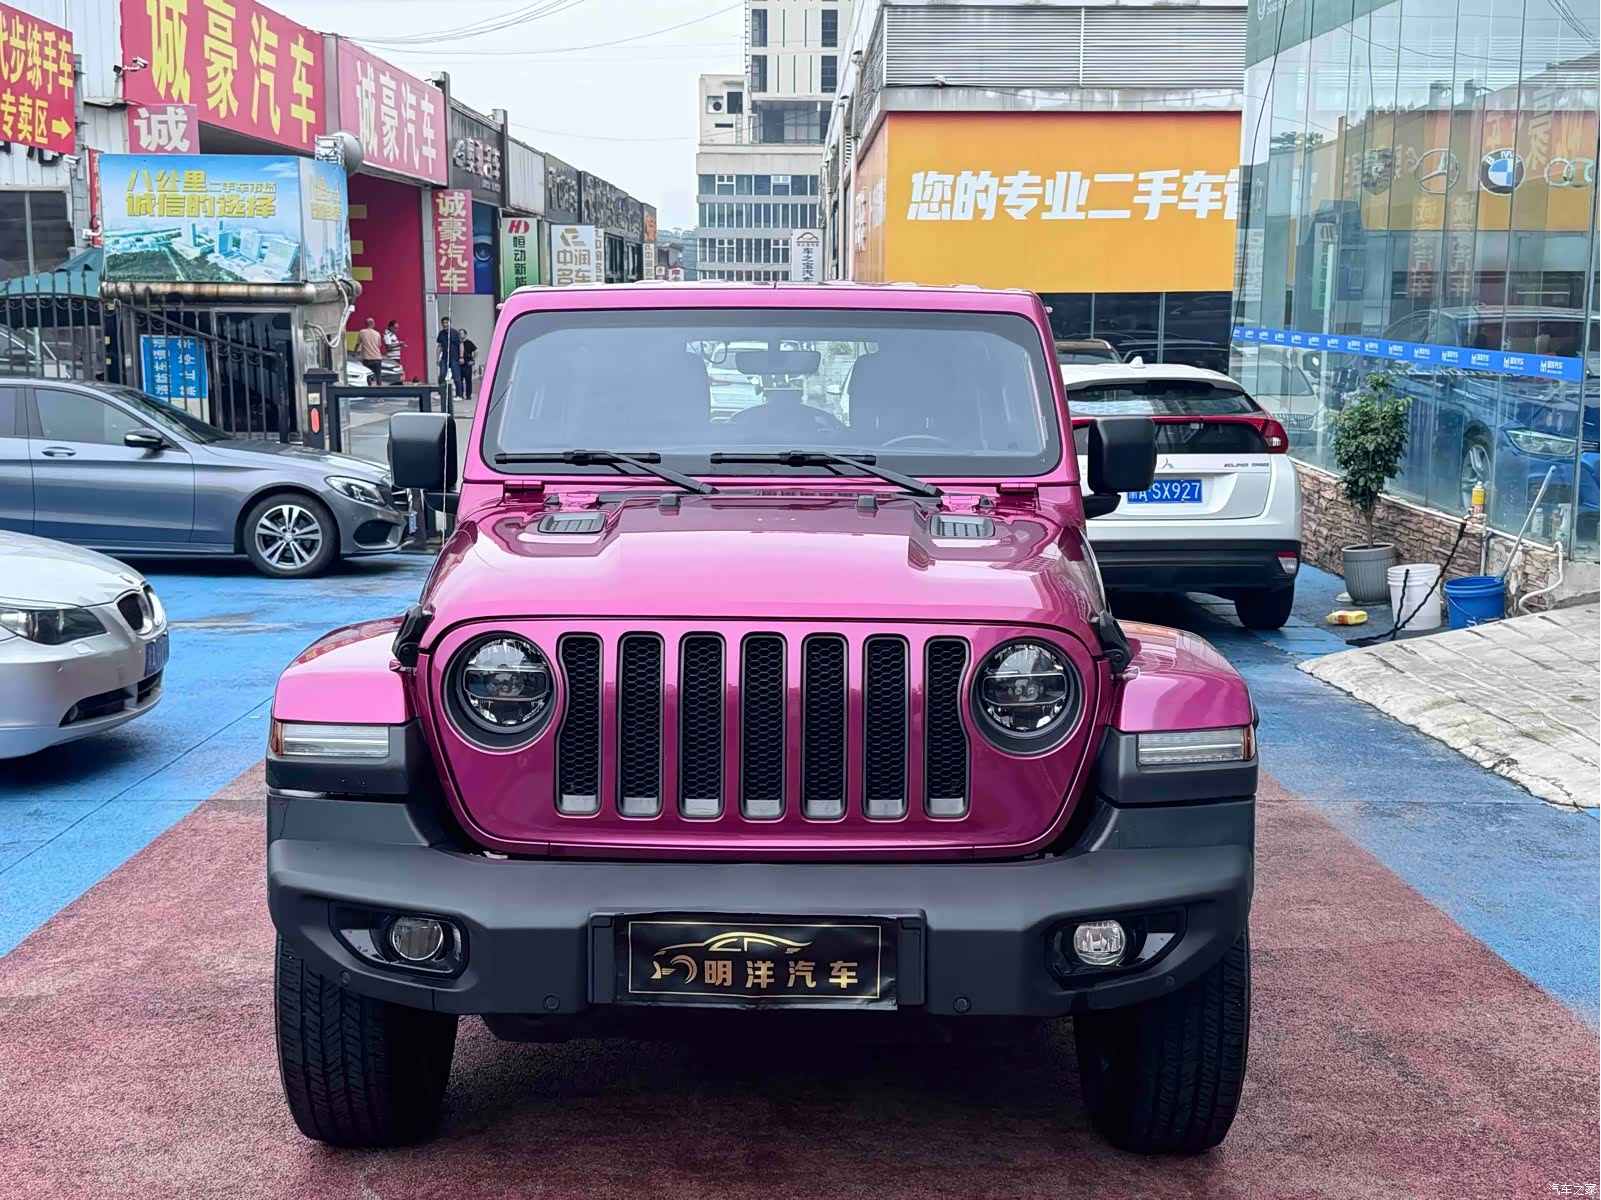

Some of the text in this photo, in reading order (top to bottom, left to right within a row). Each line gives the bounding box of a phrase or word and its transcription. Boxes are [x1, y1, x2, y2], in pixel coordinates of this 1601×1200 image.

[147, 0, 316, 144] 诚豪汽车
[0, 88, 49, 144] 专卖区
[134, 106, 190, 152] 诚
[356, 60, 437, 174] 诚豪汽车
[127, 169, 206, 193] 八公里
[127, 193, 276, 218] 诚信的选择
[435, 191, 469, 292] 诚豪汽车
[557, 249, 591, 265] 中润
[704, 959, 858, 990] 明洋汽车
